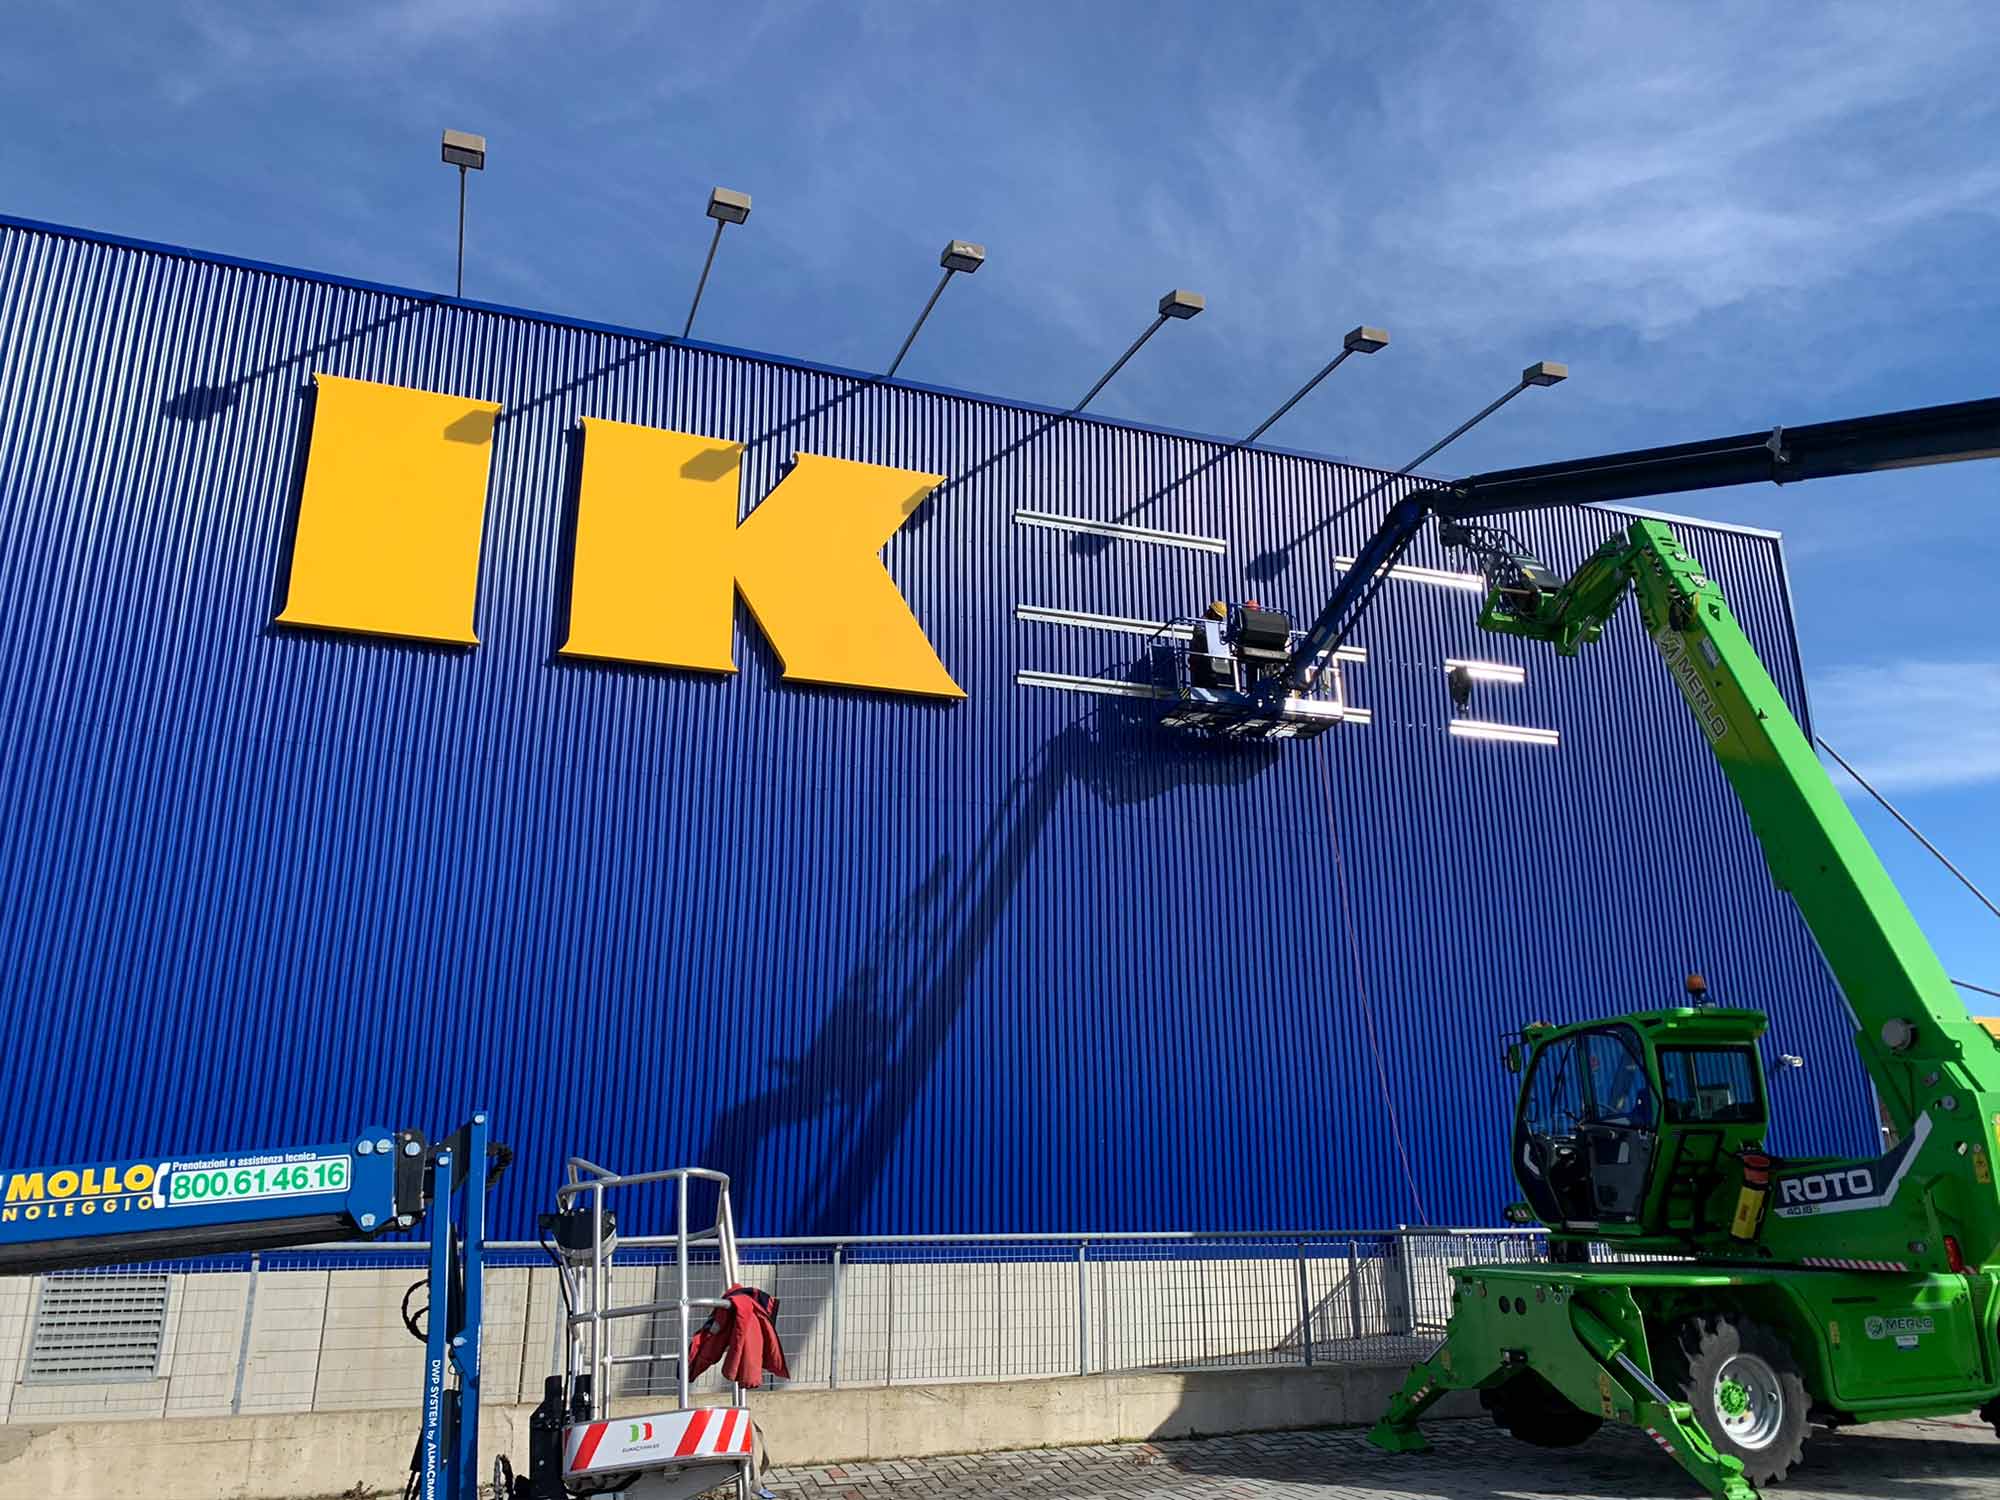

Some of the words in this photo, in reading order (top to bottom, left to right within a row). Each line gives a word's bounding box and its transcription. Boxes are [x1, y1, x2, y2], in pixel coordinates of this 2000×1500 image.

[275, 372, 968, 698] IK
[1678, 656, 1727, 738] MERLO
[172, 1157, 228, 1171] Prenotazioni
[229, 1159, 236, 1167] e
[237, 1155, 284, 1167] assistenza
[285, 1152, 317, 1162] tecnica
[5, 1164, 155, 1202] MOLLO
[172, 1162, 345, 1200] 800.61.46.16
[1780, 1169, 1874, 1203] ROTO
[2, 1196, 153, 1222] NOLEGGIO
[1886, 1318, 1933, 1329] MERLO
[431, 1359, 441, 1385] DWP
[428, 1386, 440, 1427] SYSTEM
[426, 1429, 436, 1441] by
